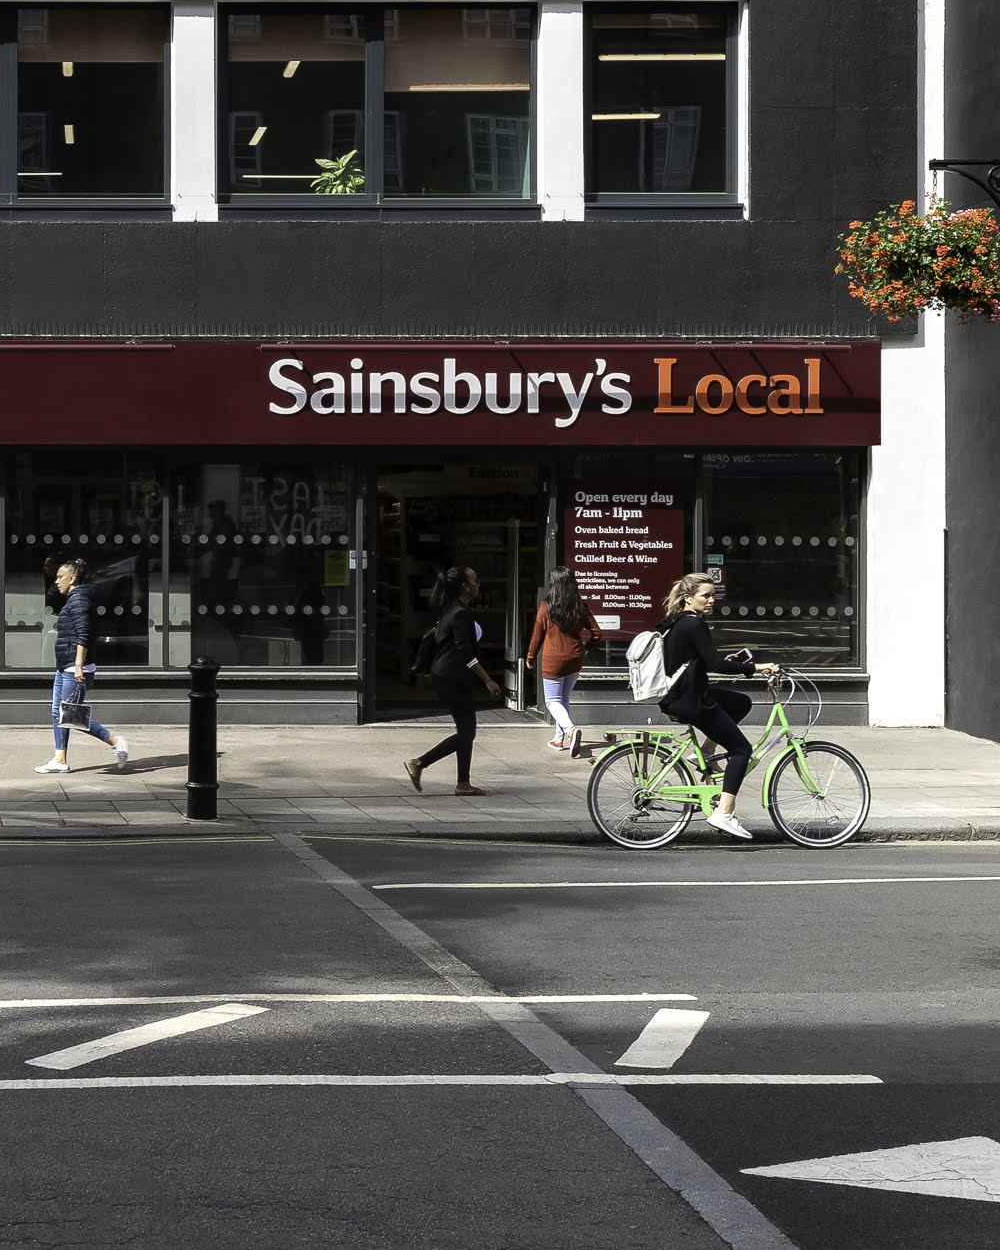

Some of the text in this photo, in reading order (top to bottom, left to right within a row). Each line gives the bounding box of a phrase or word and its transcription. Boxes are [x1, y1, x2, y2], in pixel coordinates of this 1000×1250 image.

[268, 358, 825, 428] Sainsbury's Local
[574, 491, 674, 505] Open every day
[574, 507, 603, 518] 7am
[612, 507, 643, 521] 11pm
[574, 526, 649, 534] Oven baked bread
[574, 540, 673, 550] Fresh Fruit & Vegetables
[574, 554, 658, 563] Chilled Beer & Wine
